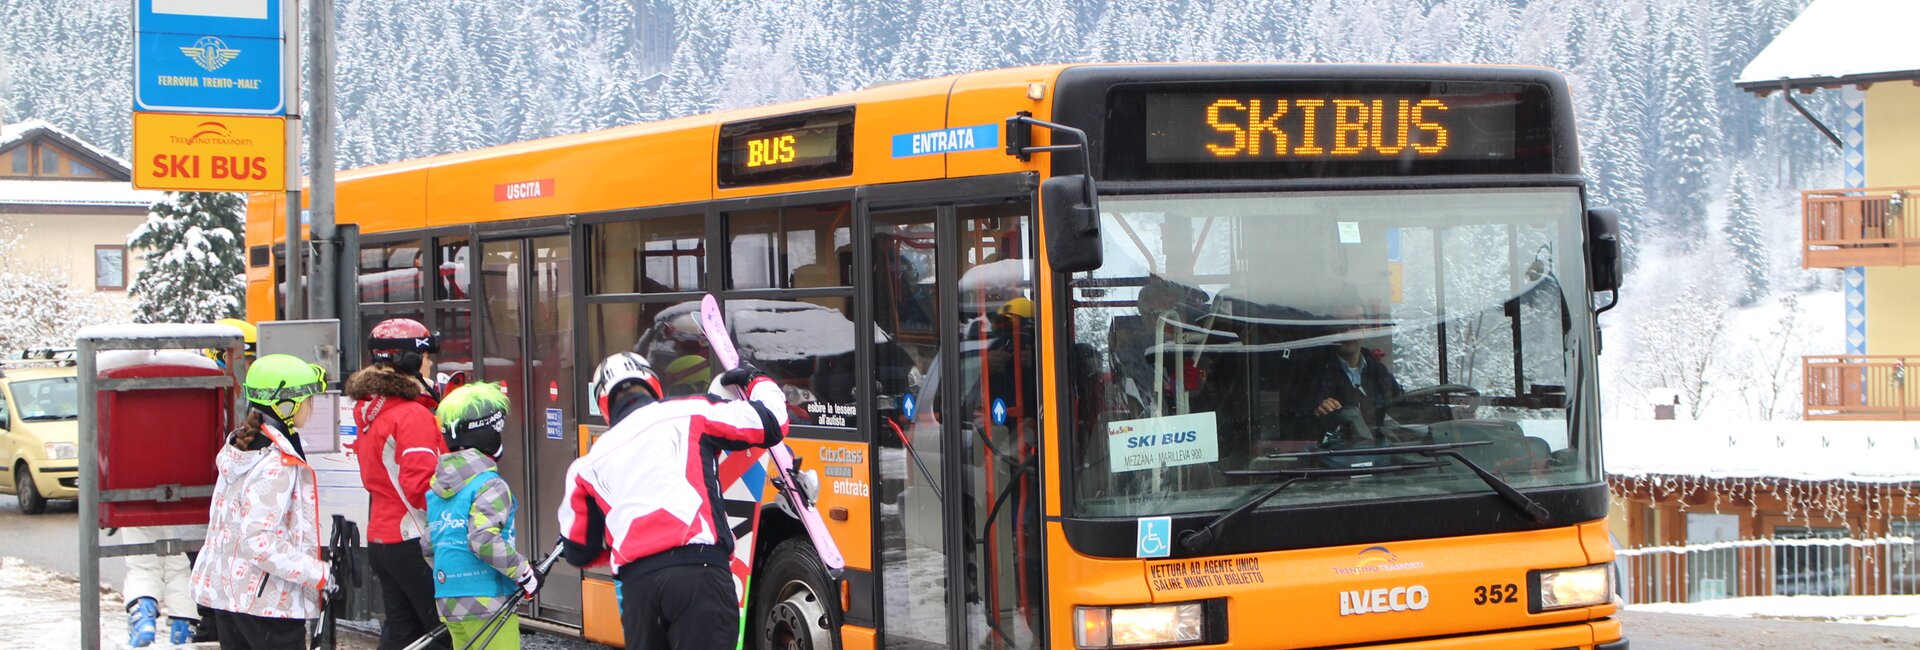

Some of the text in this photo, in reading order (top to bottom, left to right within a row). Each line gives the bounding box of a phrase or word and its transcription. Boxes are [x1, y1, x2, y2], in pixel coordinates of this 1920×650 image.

[158, 75, 199, 87] FERROVIA
[1205, 99, 1448, 156] SKIBUS
[912, 128, 975, 154] ENTRATA
[747, 135, 795, 168] BUS
[152, 153, 267, 180] SKI BUS
[507, 181, 541, 200] USCITA
[807, 402, 857, 415] esibire la tessera
[818, 414, 846, 426] all'autista
[1127, 430, 1197, 448] SKI BUS
[819, 446, 863, 464] CityClass
[1124, 453, 1154, 467] MEZZANA
[1158, 449, 1191, 464] MARILLEVA
[1191, 448, 1203, 460] 900
[833, 478, 869, 497] entrata
[1151, 557, 1260, 578] VETTURA AD AGENTE UNICO
[1332, 565, 1378, 575] TRENTINO
[1153, 571, 1264, 592] SALIRE MUNITI DI BIGLIETTO
[1340, 584, 1519, 616] IVECO 352
